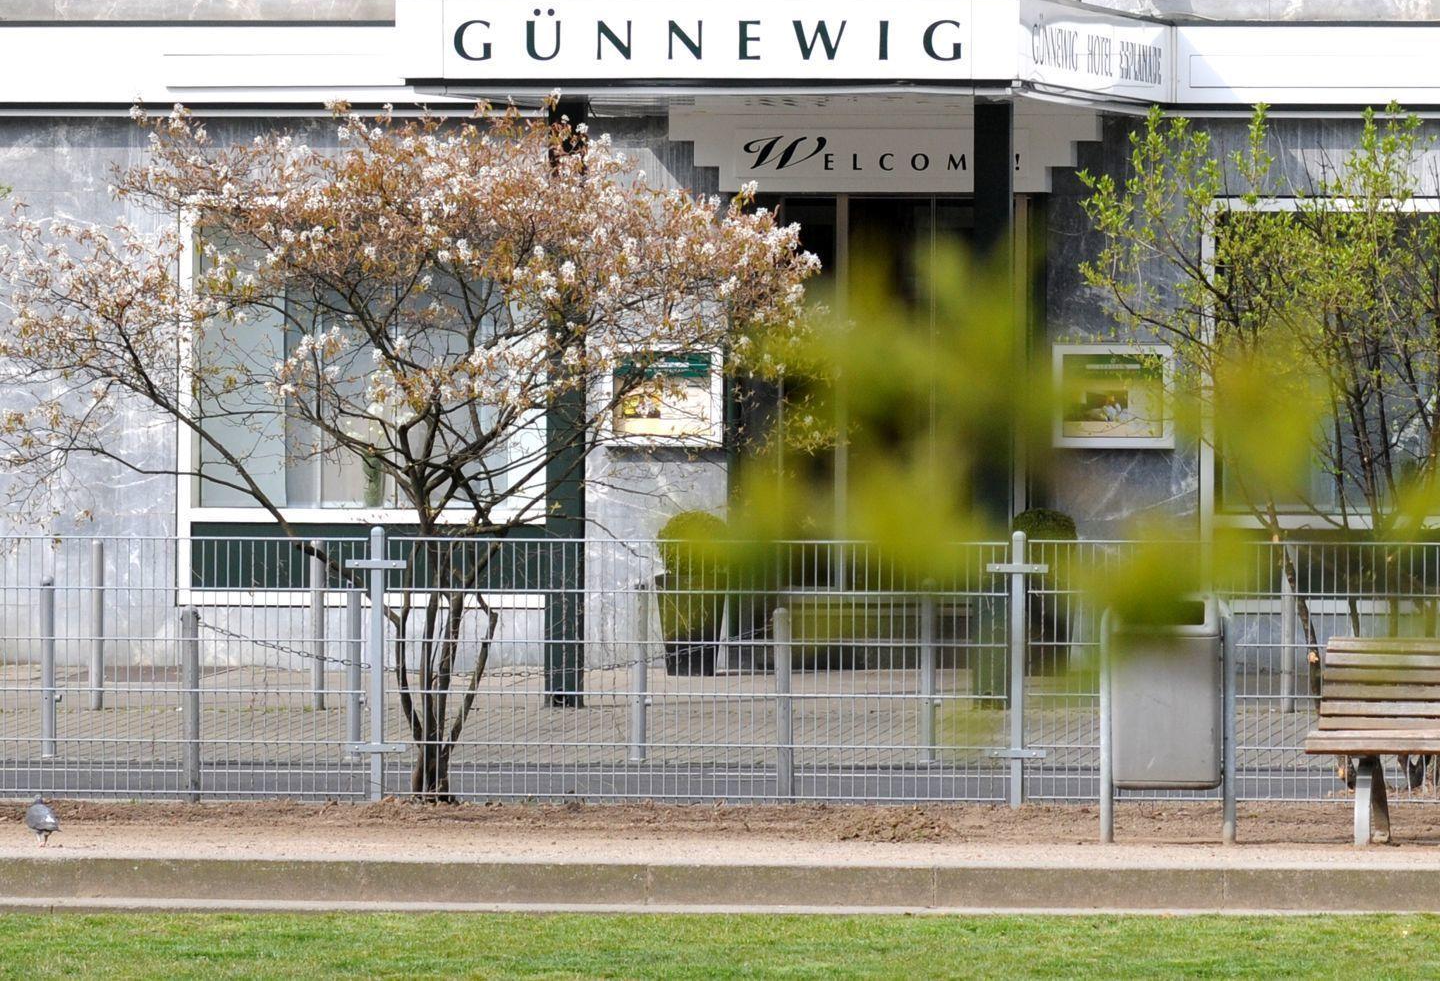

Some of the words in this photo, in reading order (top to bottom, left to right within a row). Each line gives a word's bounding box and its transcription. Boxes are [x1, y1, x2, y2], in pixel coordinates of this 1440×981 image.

[453, 8, 963, 62] GÜNNEWIG
[1031, 13, 1078, 72] GÜNNEWIG
[1087, 34, 1113, 78] HOTEL
[1119, 40, 1162, 85] ESPLANADE
[743, 135, 1021, 171] WELCOM!
